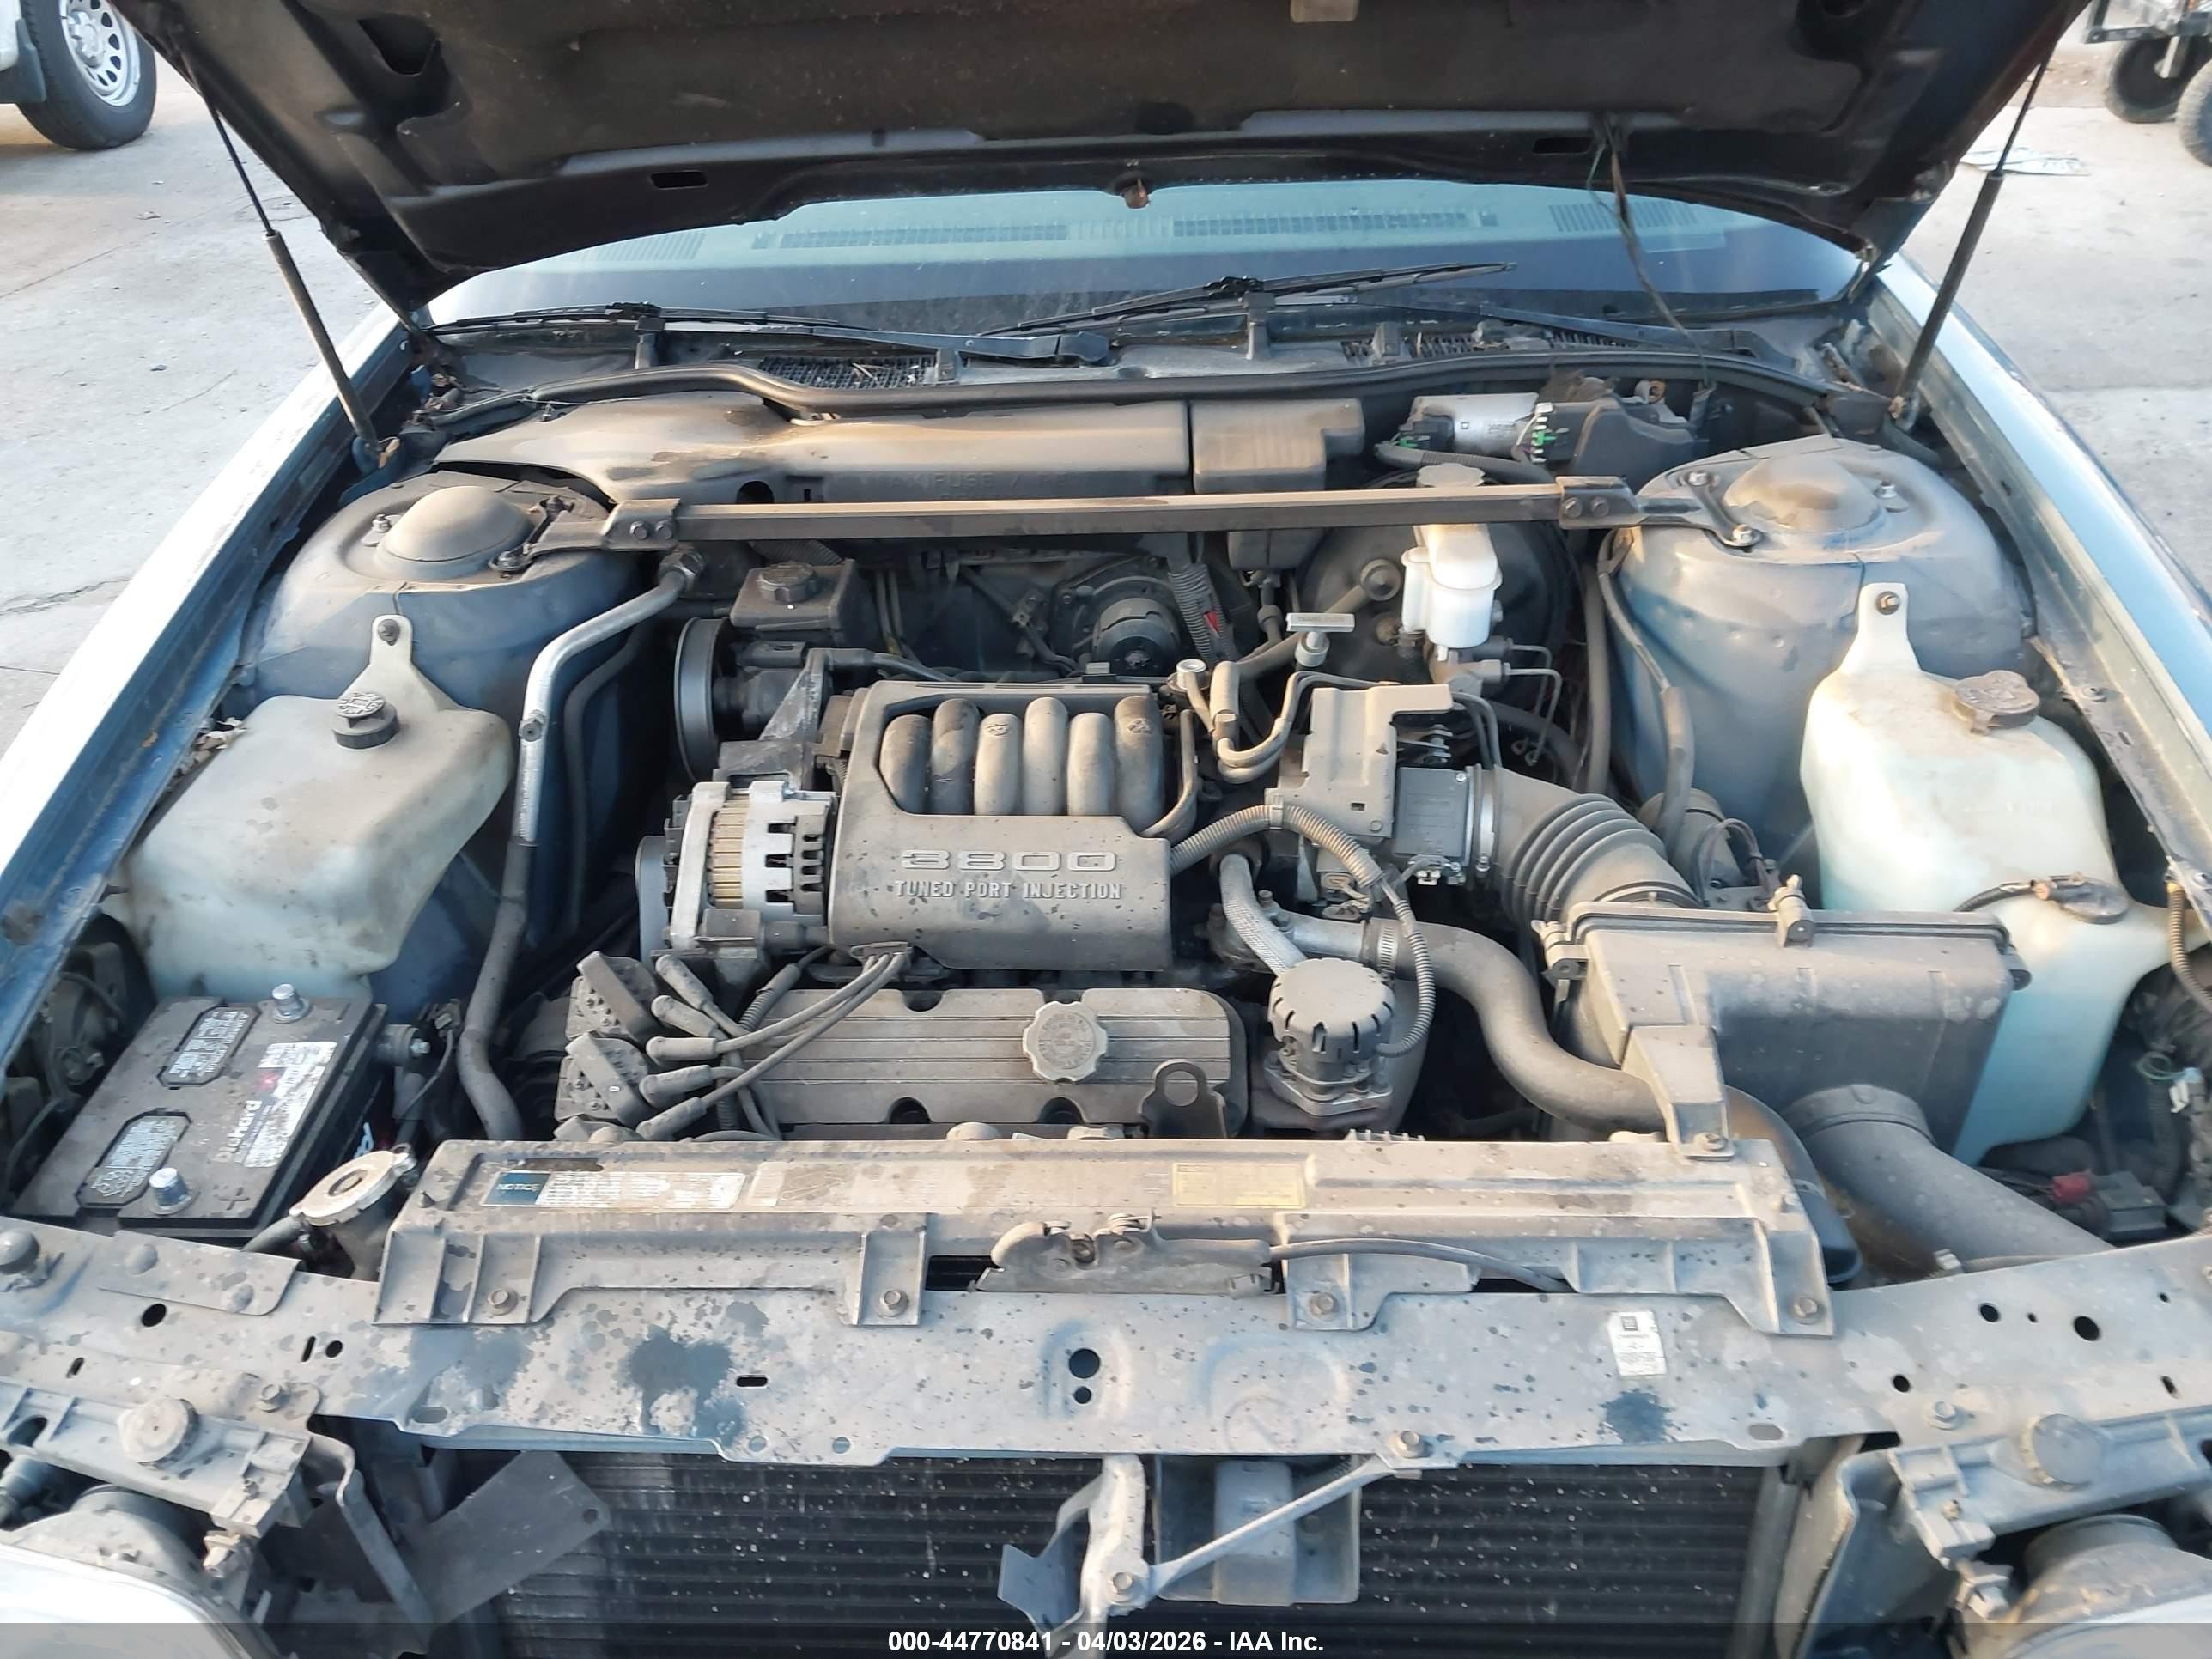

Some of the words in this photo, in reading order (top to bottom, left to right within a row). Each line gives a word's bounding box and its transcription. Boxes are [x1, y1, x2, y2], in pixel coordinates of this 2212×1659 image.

[901, 849, 1117, 872] 3800
[895, 880, 955, 898] TUNED
[963, 881, 1012, 899] PORT
[1023, 882, 1123, 900] INJECTION
[497, 1182, 540, 1193] NOTICE
